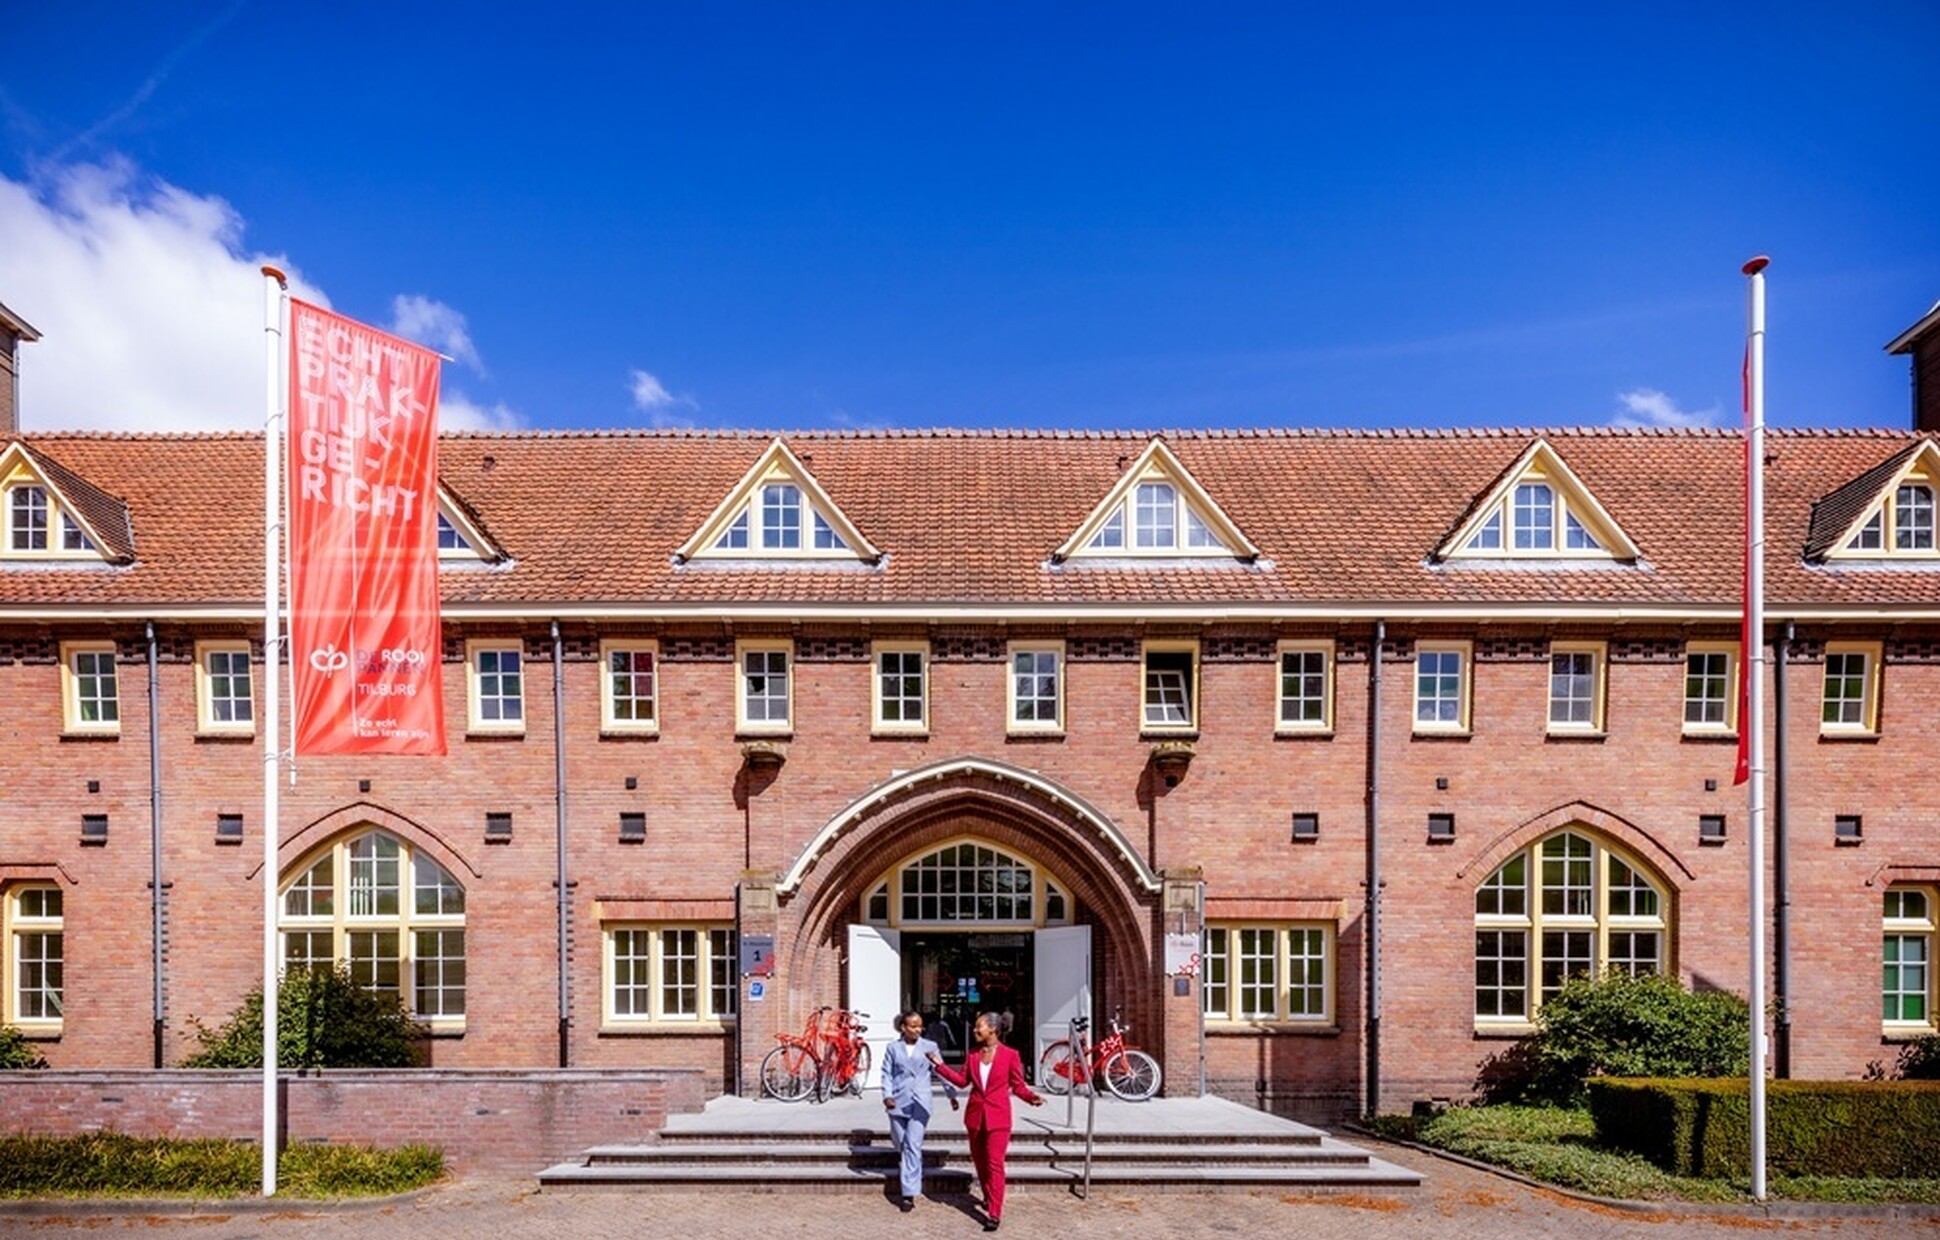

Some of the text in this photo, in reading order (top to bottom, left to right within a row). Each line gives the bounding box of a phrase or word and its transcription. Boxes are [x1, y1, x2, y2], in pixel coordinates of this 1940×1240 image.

[300, 316, 405, 384] ECHT
[300, 350, 426, 419] PRAK-
[300, 389, 394, 451] TIJK
[300, 429, 381, 474] GE-
[301, 465, 418, 522] RICHT
[358, 683, 416, 697] TILBURG
[754, 949, 761, 962] 1
